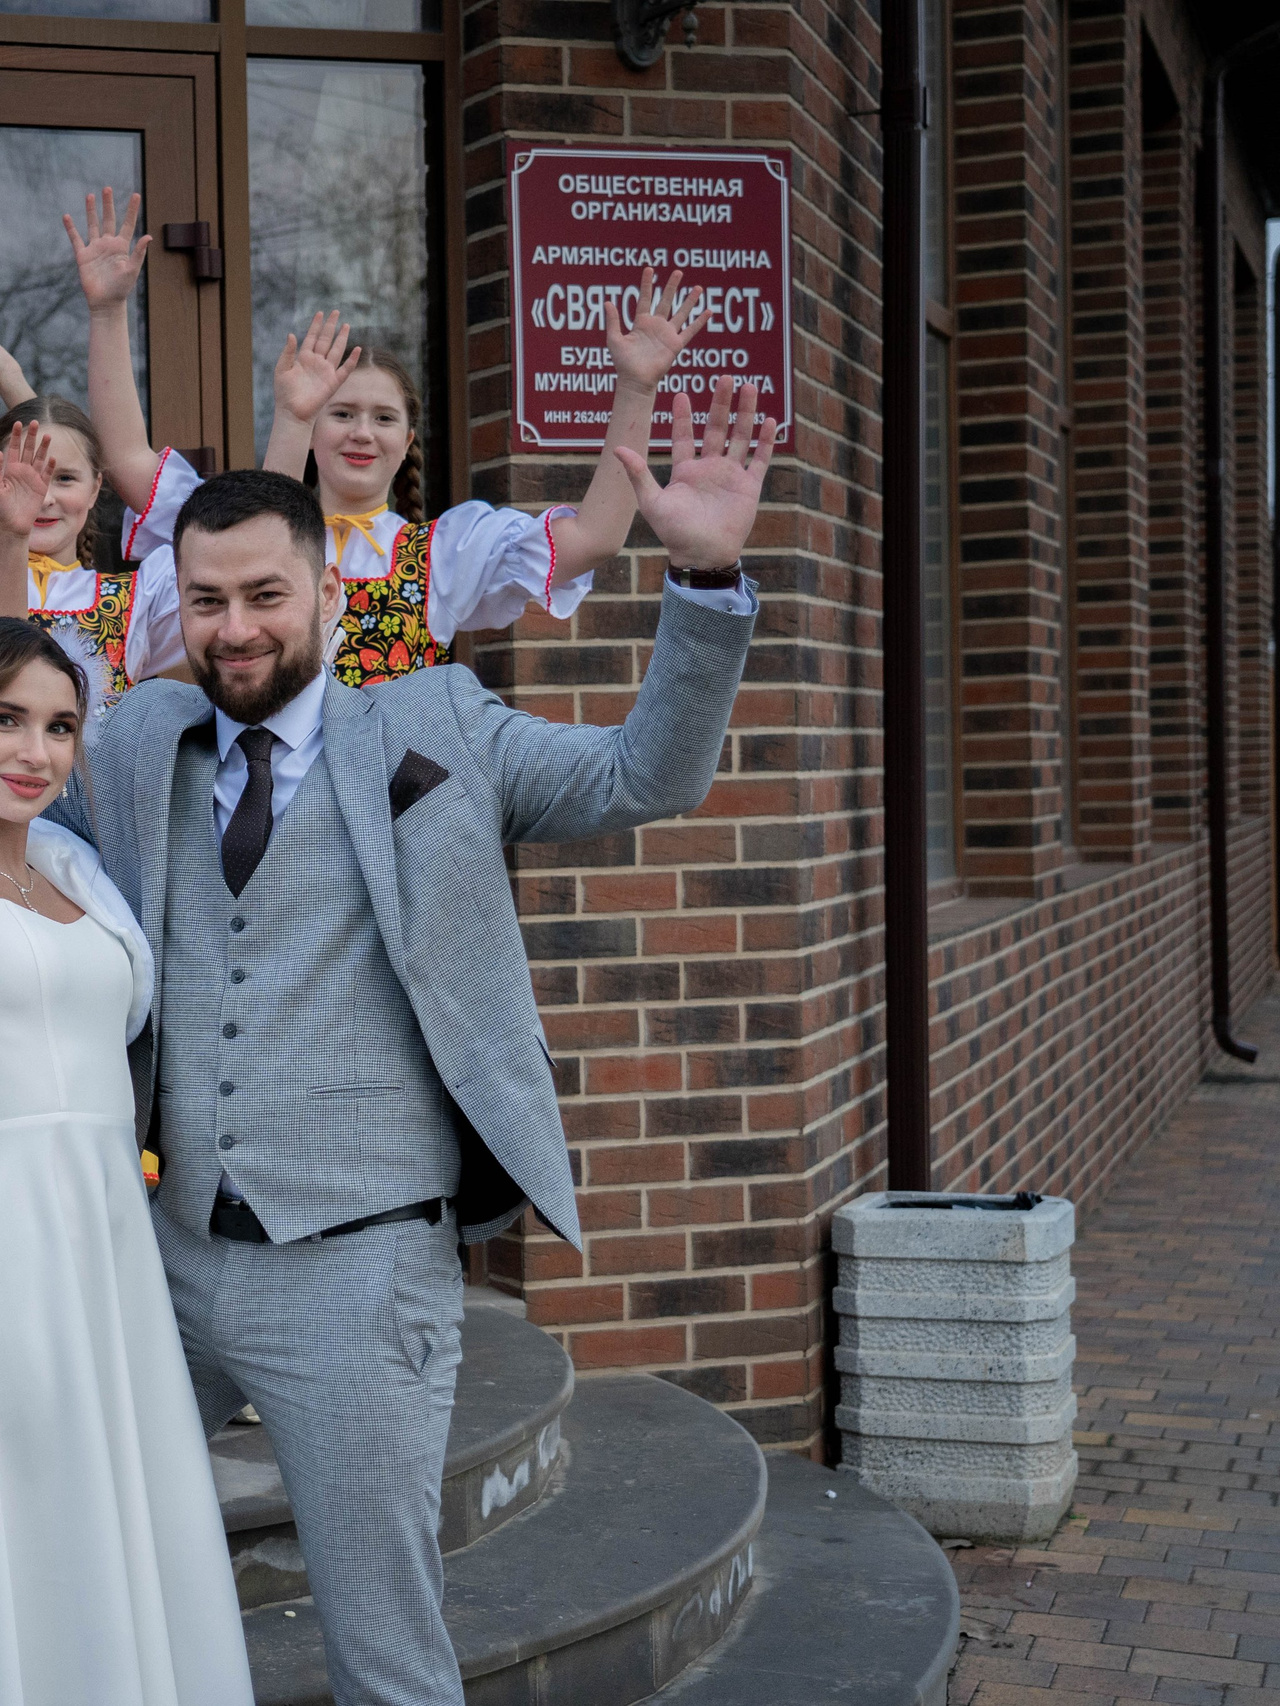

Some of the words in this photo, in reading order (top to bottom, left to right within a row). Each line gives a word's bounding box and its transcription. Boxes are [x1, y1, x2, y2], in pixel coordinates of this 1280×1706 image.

[558, 174, 744, 198] ОБЩЕСТВЕННАЯ
[571, 201, 733, 226] ОРГАНИЗАЦИЯ
[531, 245, 668, 268] АРМЯНСКАЯ
[673, 249, 772, 272] ОБЩИНА
[544, 410, 571, 424] ИНН
